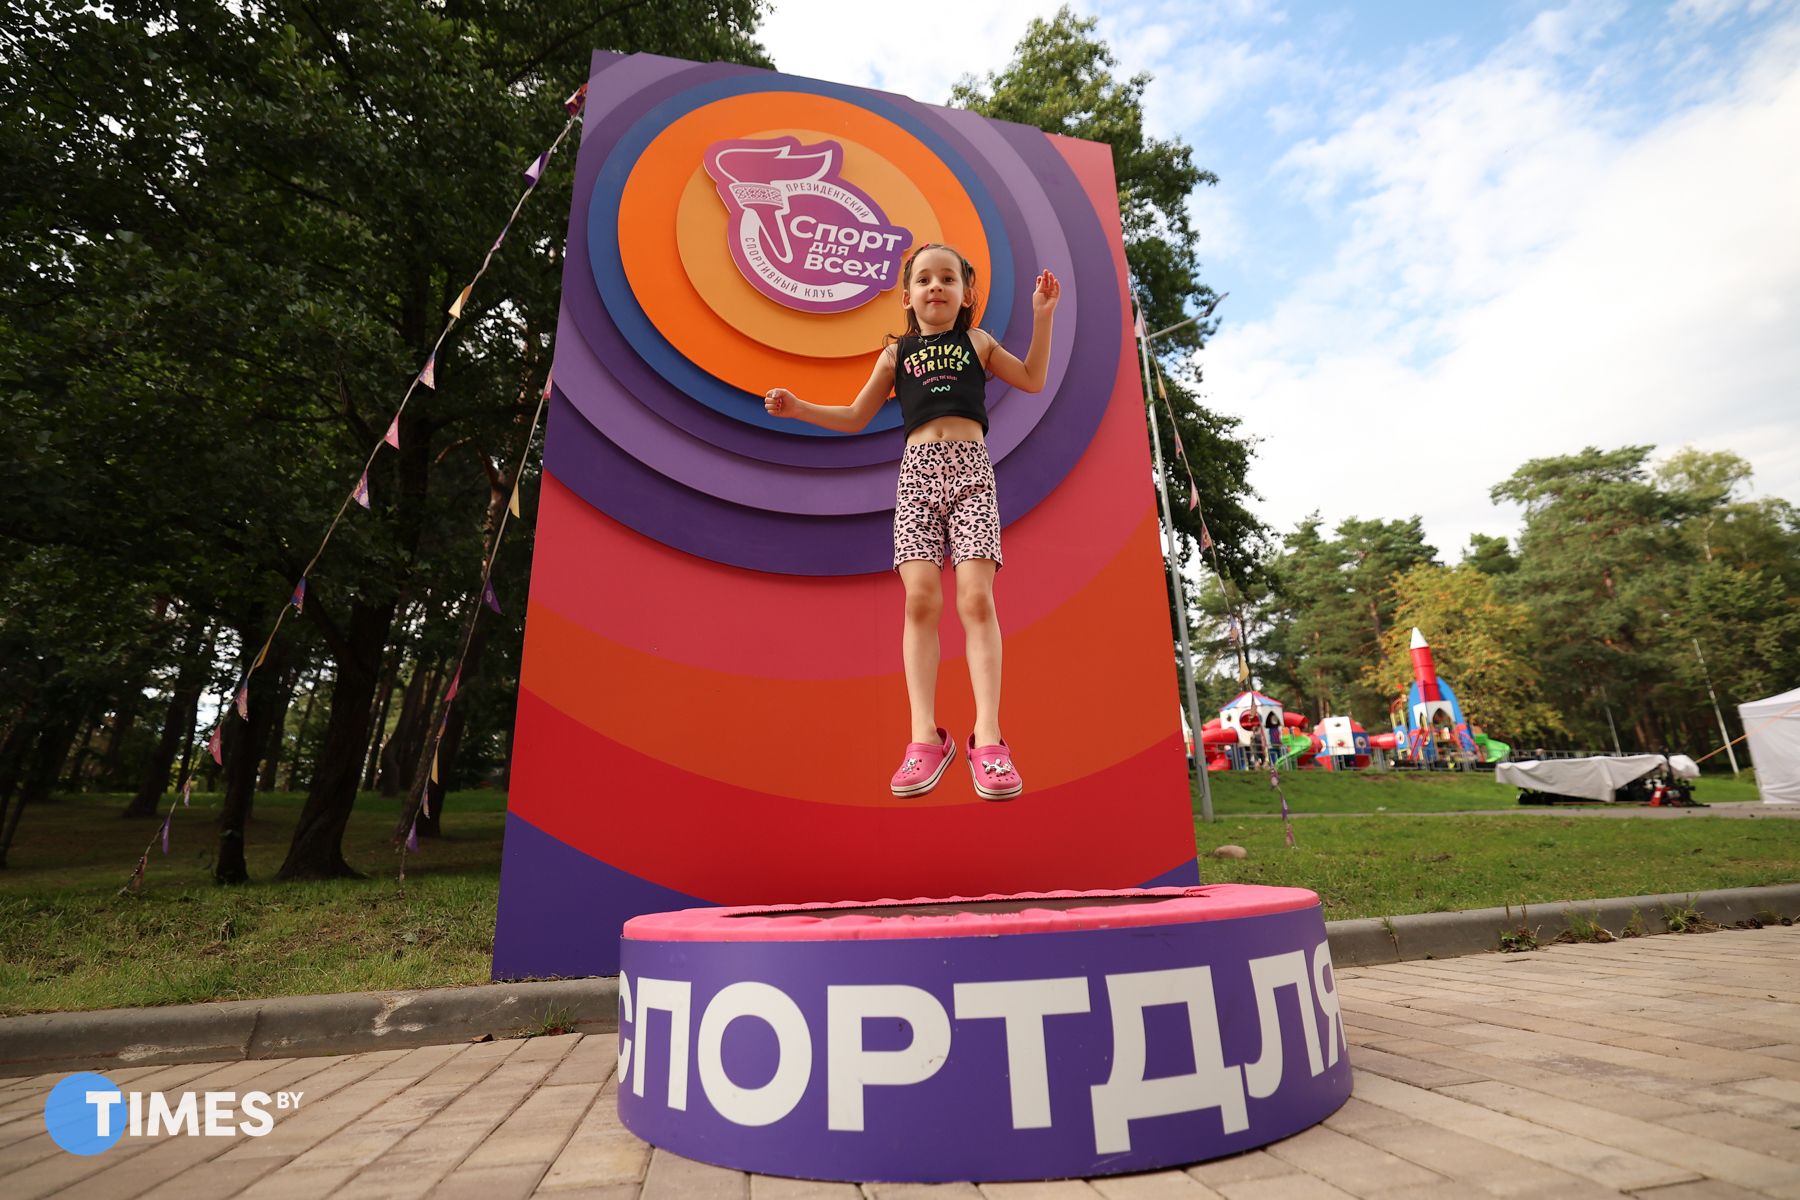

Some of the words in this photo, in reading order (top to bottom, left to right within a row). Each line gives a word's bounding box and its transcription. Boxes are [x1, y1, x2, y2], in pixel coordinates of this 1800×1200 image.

[785, 182, 870, 218] ПРЕЗИДЕНТСКИЙ
[789, 215, 903, 253] Спорт
[744, 237, 799, 293] СПОРТИВНЫЙ
[804, 287, 834, 298] КЛУБ
[903, 343, 971, 375] FESTIVAL
[913, 357, 964, 378] GIRLIES
